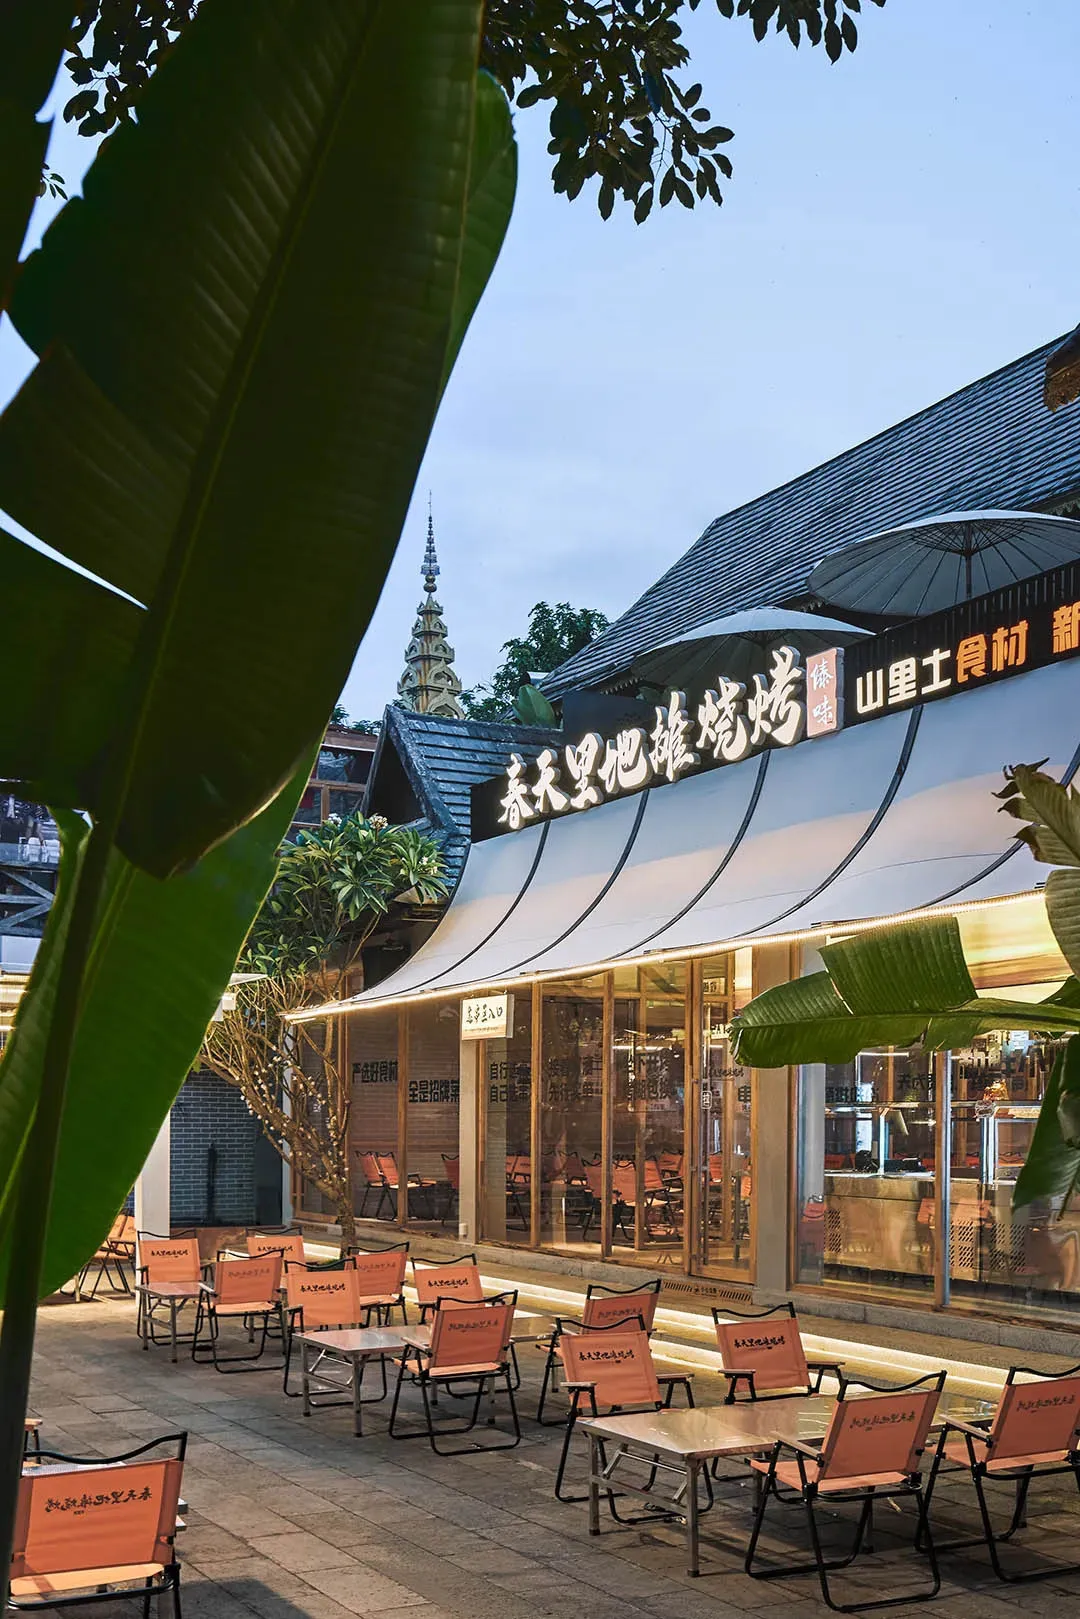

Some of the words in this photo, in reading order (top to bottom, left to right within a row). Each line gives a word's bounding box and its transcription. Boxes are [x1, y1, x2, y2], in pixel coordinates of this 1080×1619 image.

[810, 658, 834, 726] 傣味
[856, 620, 1028, 714] 山里土食材
[498, 646, 803, 829] 春天里地摊烧烤
